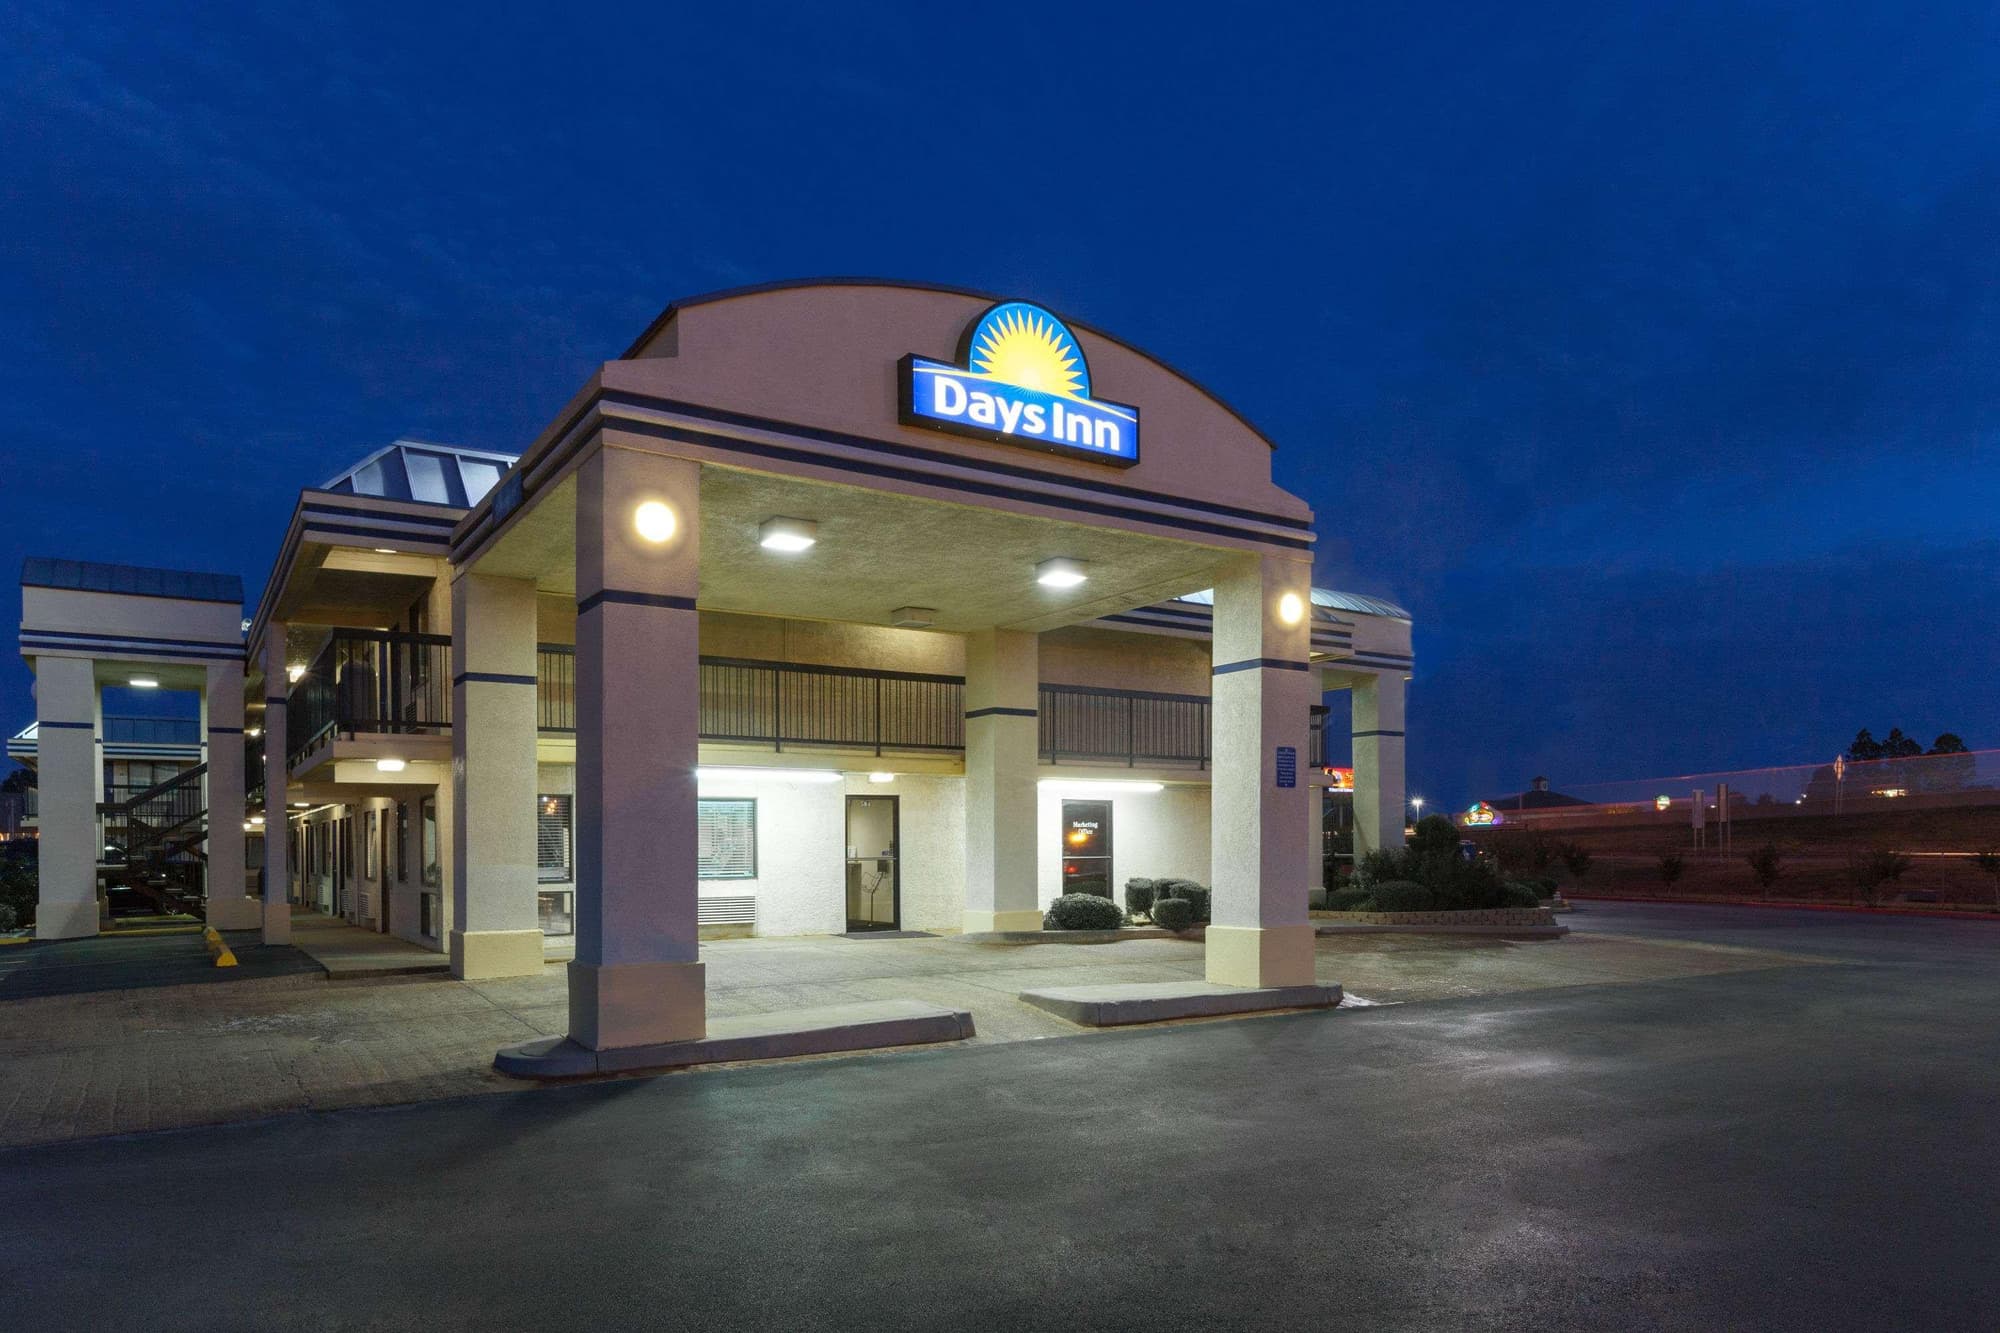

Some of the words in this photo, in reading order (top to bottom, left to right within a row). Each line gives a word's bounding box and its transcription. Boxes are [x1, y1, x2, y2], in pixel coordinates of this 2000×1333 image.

[934, 375, 1046, 434] Days
[1053, 402, 1121, 451] Inn
[1072, 820, 1098, 829] Marketing
